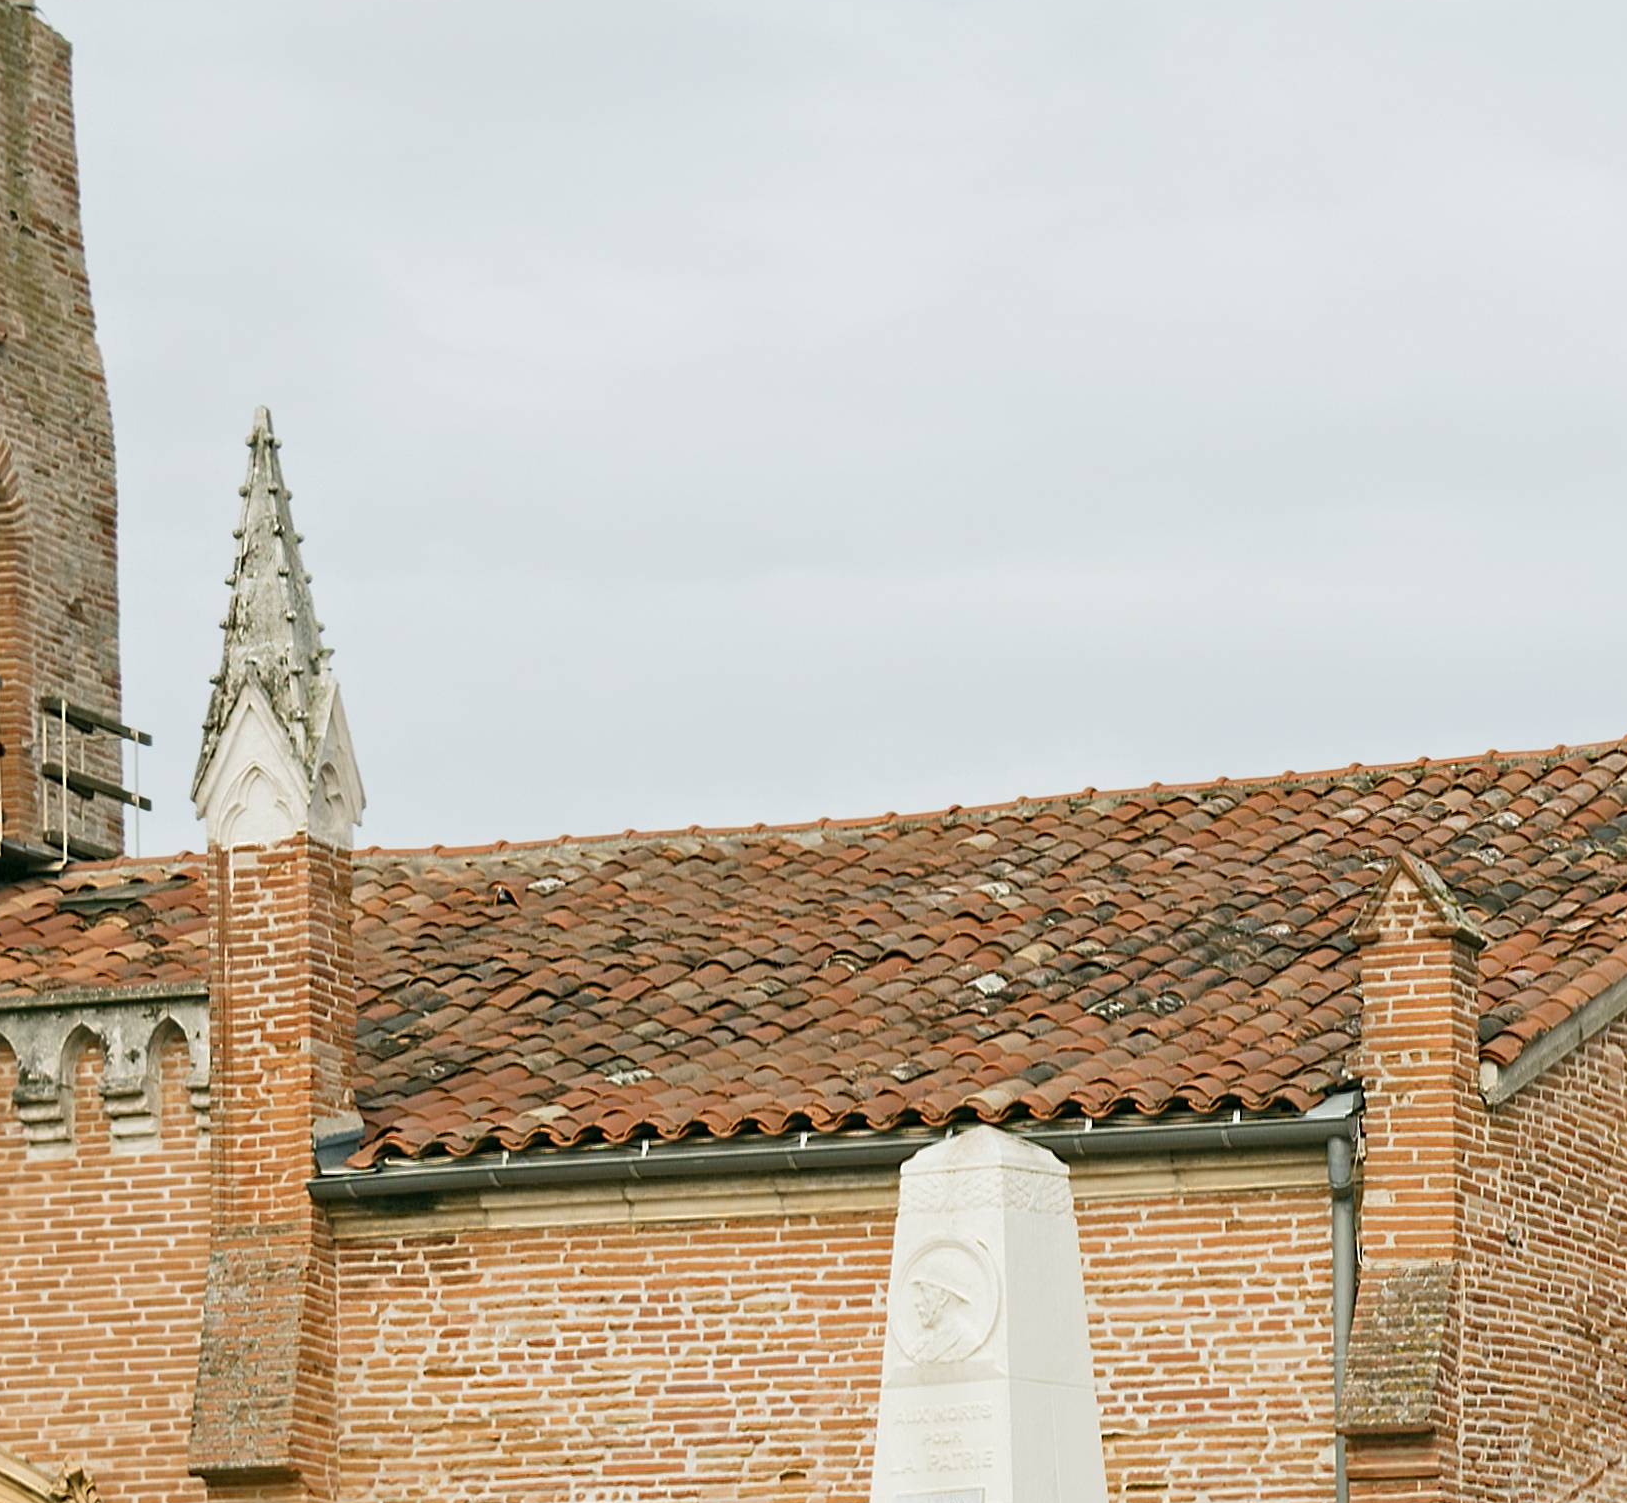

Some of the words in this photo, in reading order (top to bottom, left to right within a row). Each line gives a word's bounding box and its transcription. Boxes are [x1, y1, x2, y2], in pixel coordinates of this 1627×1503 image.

[893, 1406, 930, 1425] AUX
[932, 1402, 993, 1423] MORTS
[922, 1431, 962, 1446] POUR
[890, 1454, 919, 1474] LA
[927, 1449, 994, 1472] PATRIE
